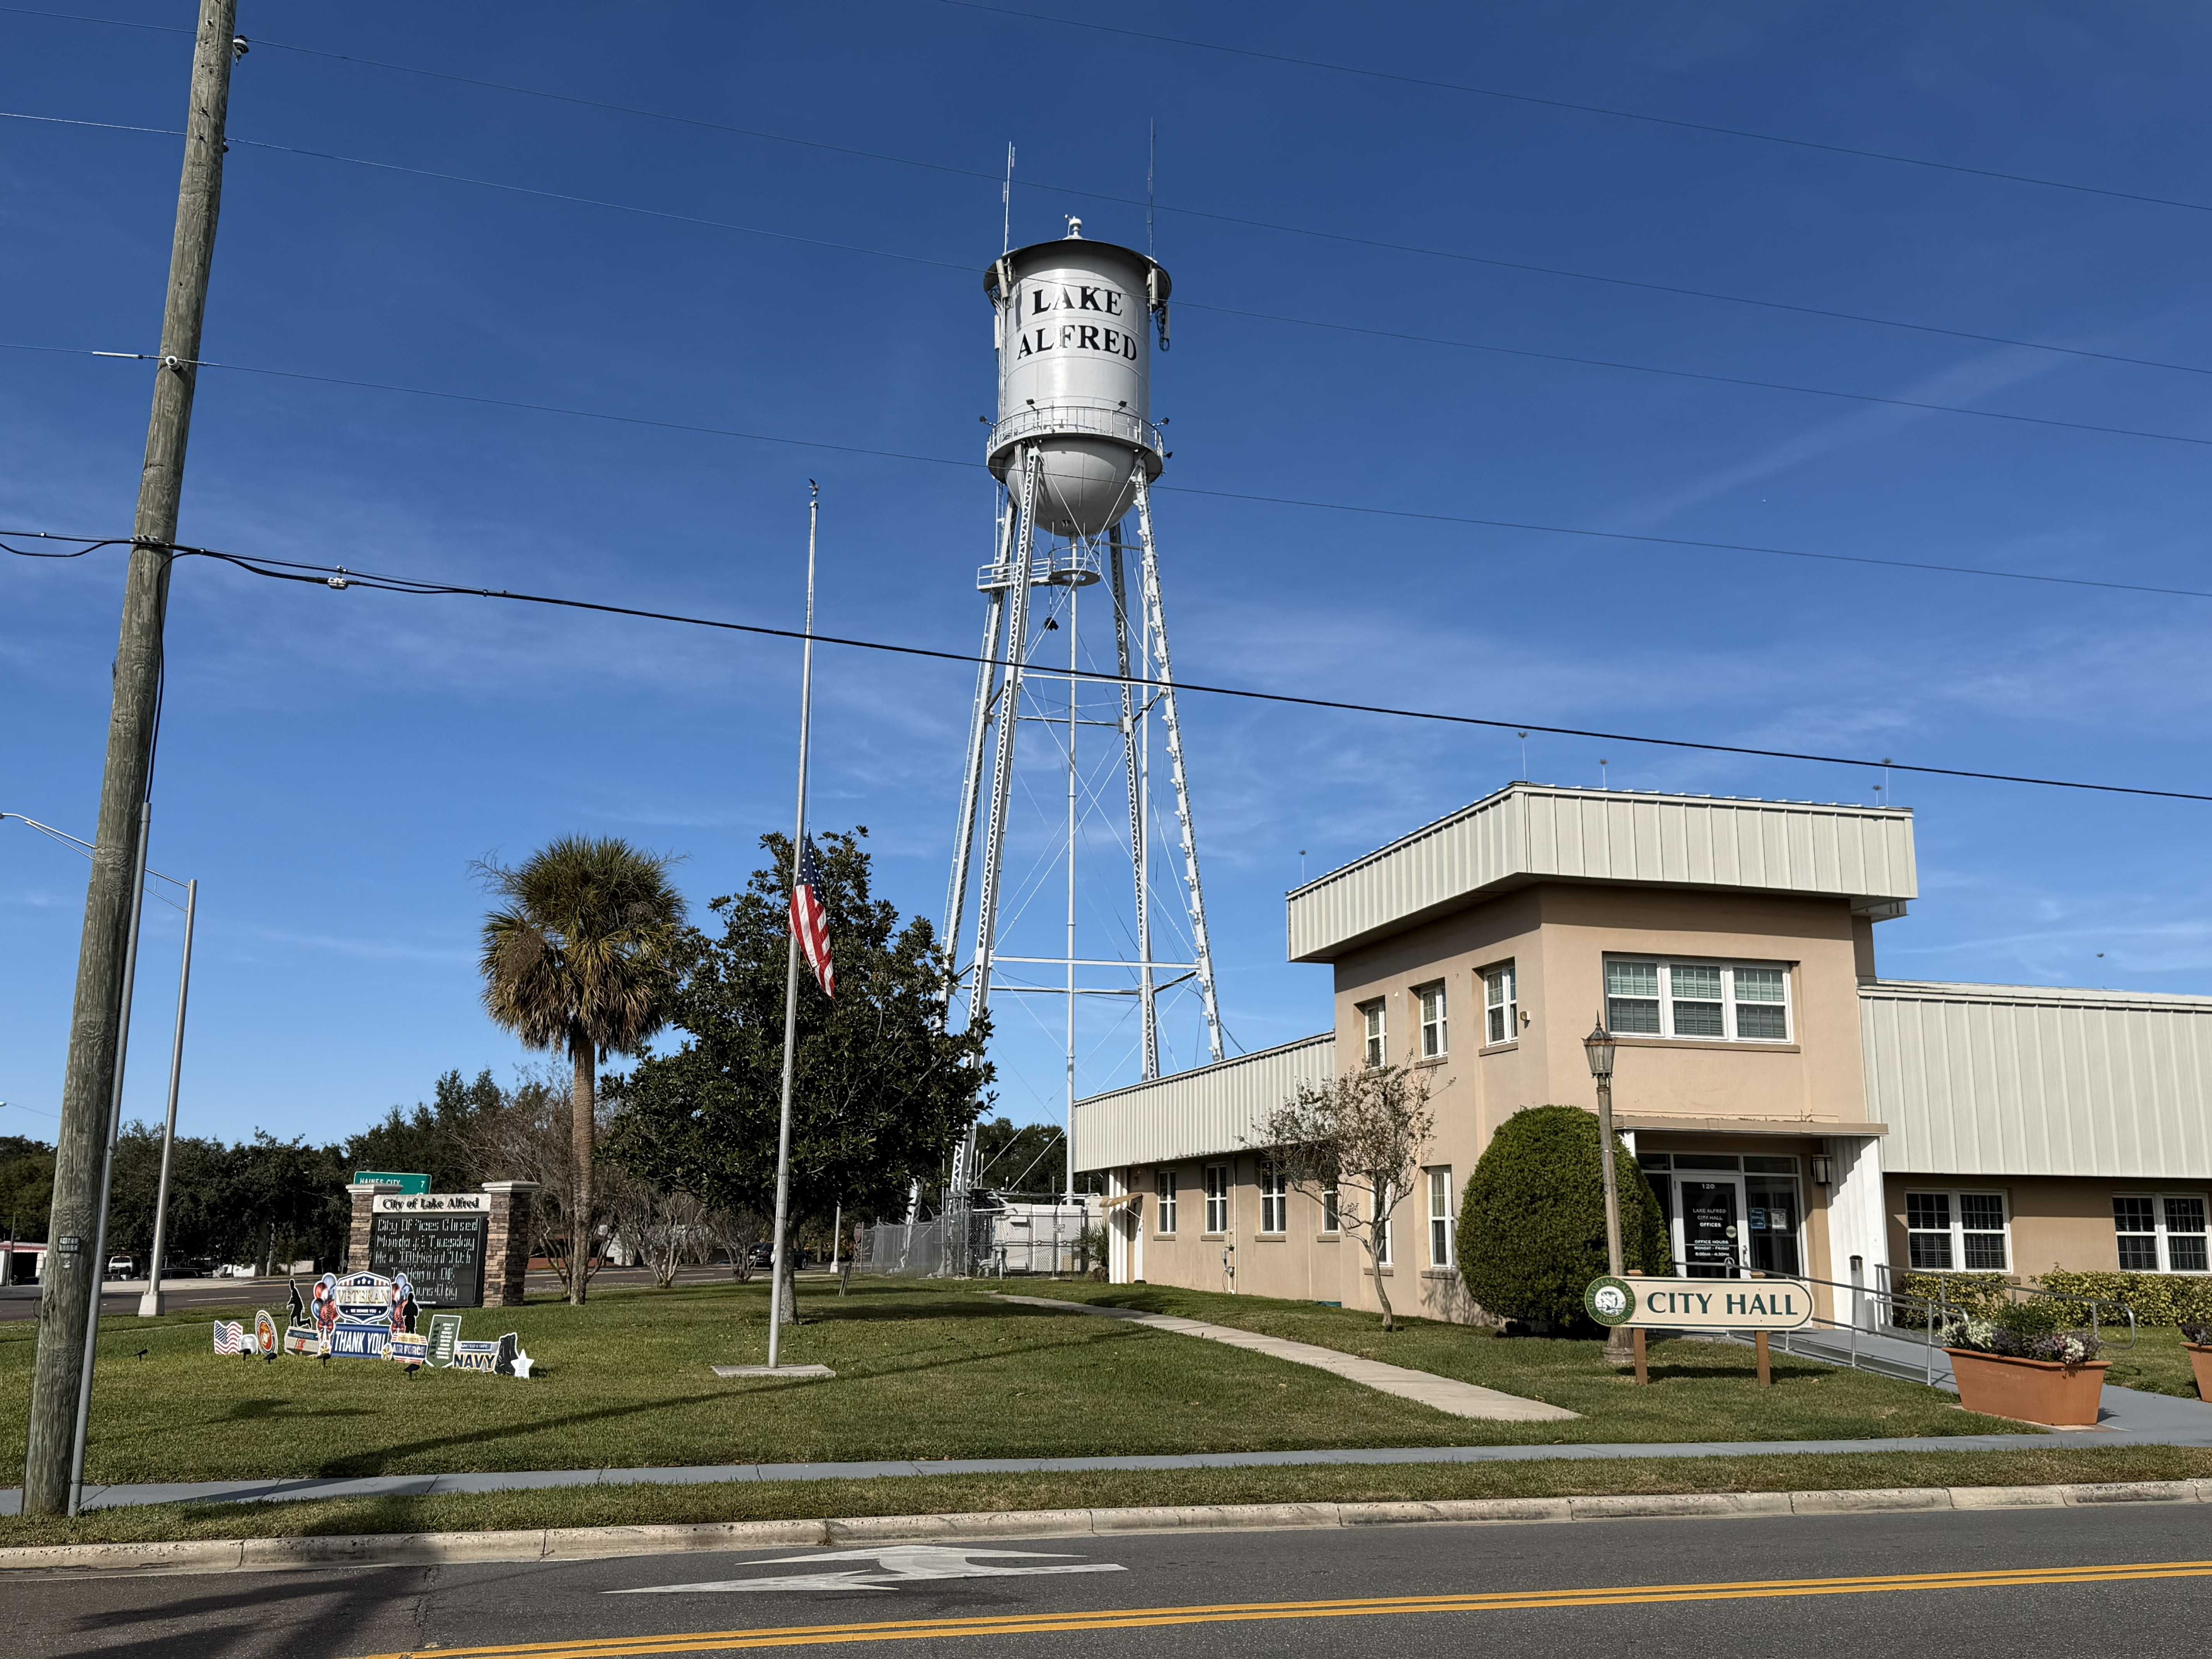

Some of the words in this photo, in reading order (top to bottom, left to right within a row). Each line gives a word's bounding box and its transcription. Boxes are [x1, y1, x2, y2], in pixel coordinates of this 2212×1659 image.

[1032, 286, 1122, 316] LAKE
[1017, 325, 1137, 360] ALFRED
[383, 1199, 404, 1211] City
[407, 1198, 418, 1209] of
[421, 1198, 444, 1209] Lake
[447, 1197, 479, 1209] Alfred
[337, 1289, 390, 1304] VETERAN
[1591, 1282, 1600, 1292] OF
[1620, 1285, 1633, 1311] ALFRED
[1647, 1292, 1712, 1313] CITY
[1726, 1294, 1798, 1315] HALL
[1595, 1313, 1626, 1324] FLORIDA
[335, 1331, 366, 1353] THANK
[368, 1333, 386, 1354] YOU
[393, 1343, 403, 1353] AIR
[404, 1345, 426, 1355] FORCE
[454, 1354, 496, 1368] NAVY
